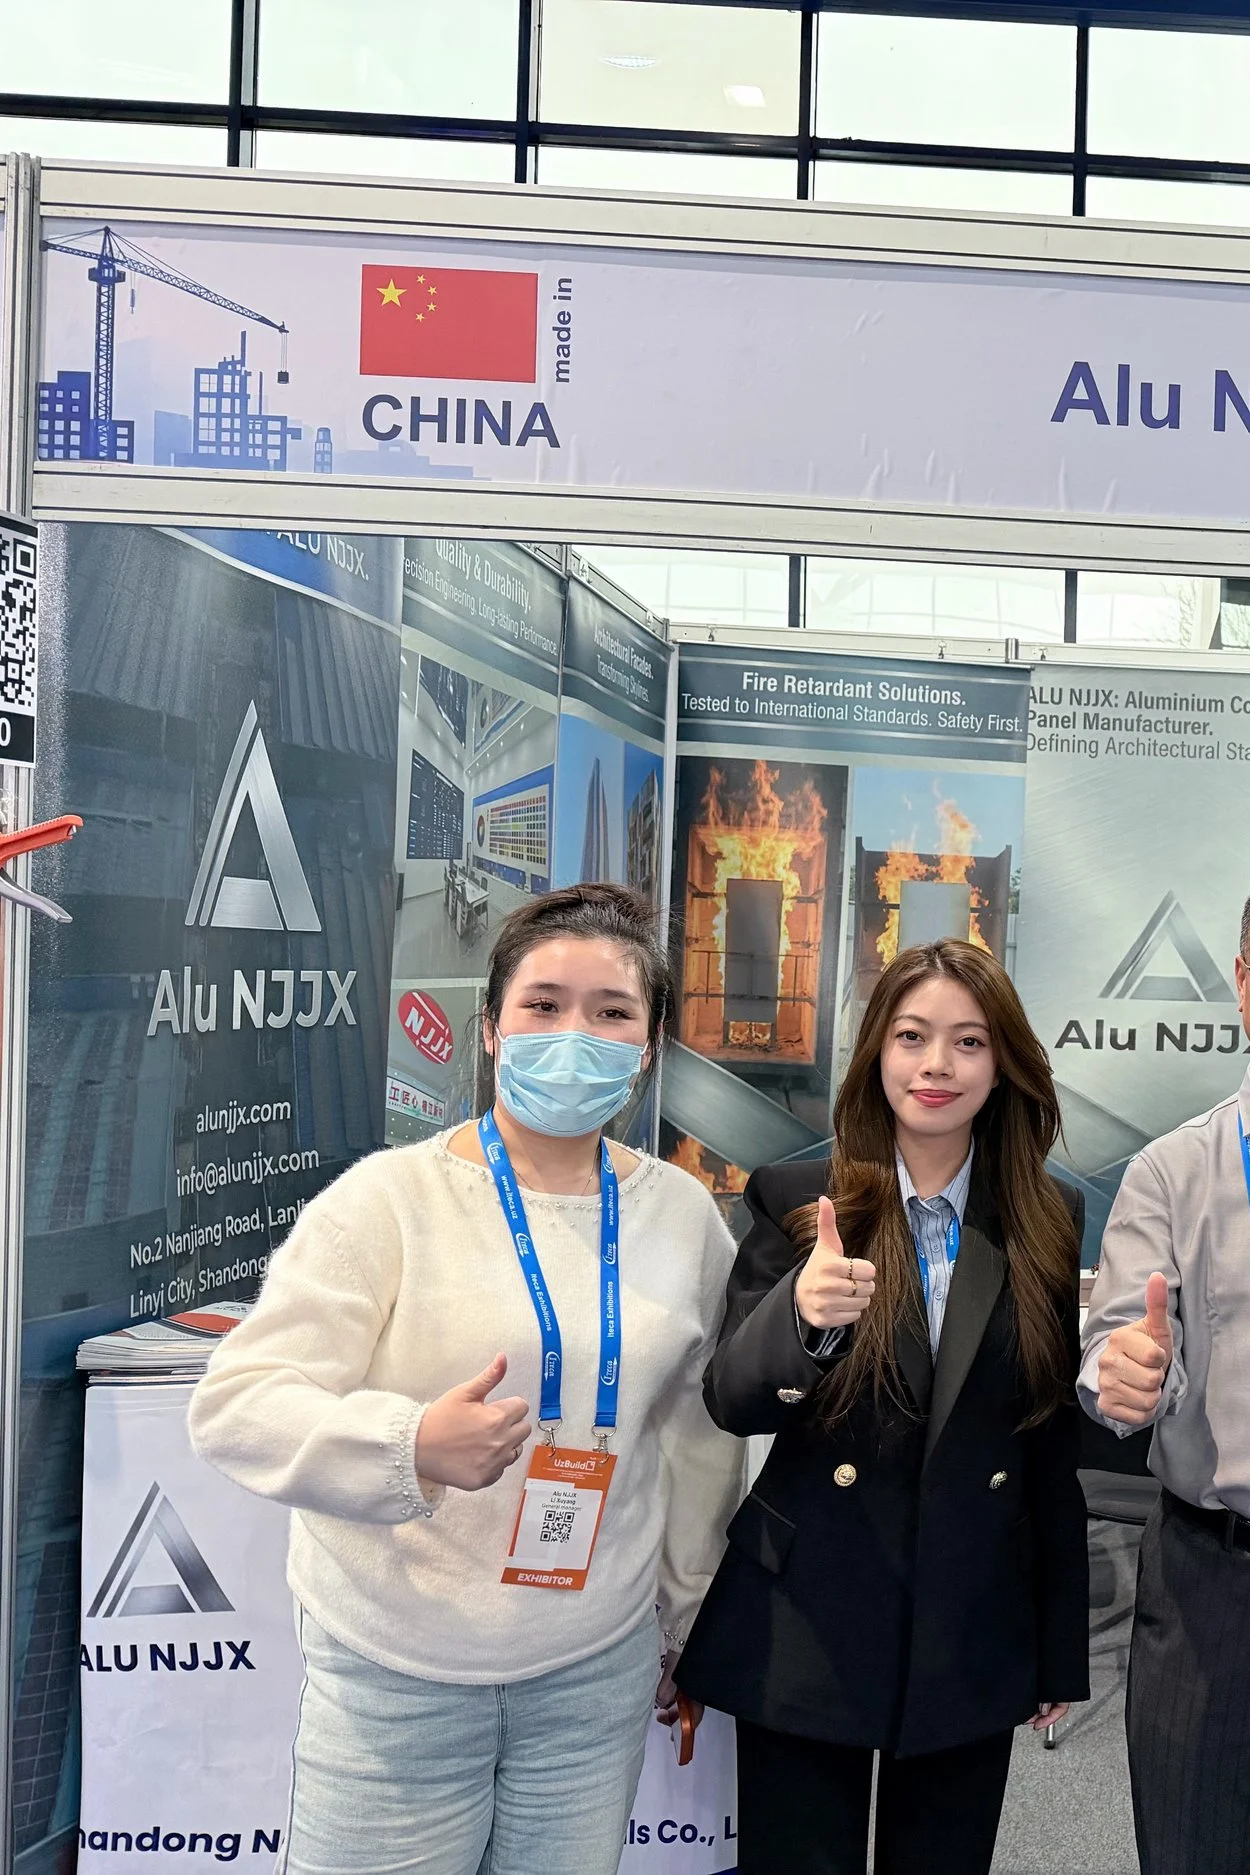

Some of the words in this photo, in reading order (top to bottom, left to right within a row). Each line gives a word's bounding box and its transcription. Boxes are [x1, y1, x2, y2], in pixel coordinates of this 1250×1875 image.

[553, 278, 572, 301] in
[552, 310, 571, 383] made
[1051, 361, 1181, 429] Alu
[362, 394, 561, 448] CHINA
[474, 554, 481, 581] &
[485, 559, 532, 615] Durability.
[742, 672, 777, 692] Fire
[784, 674, 873, 700] Retardant
[879, 681, 967, 706] Solutions.
[1069, 688, 1119, 709] NJJX:
[1124, 691, 1225, 714] Aluminium
[682, 693, 731, 713] Tested
[734, 696, 750, 714] to
[754, 698, 849, 721] International
[853, 704, 932, 728] Standards.
[937, 711, 984, 734] Safety
[988, 714, 1024, 734] First.
[1027, 710, 1077, 730] Panel
[1083, 713, 1214, 736] Manufacturer.
[1026, 733, 1100, 760] Defining
[1104, 736, 1220, 760] Architectural
[147, 966, 217, 1036] Alu
[232, 969, 357, 1030] NJJX
[404, 1007, 453, 1060] NJJX
[1054, 1019, 1137, 1051] Alu
[197, 1100, 291, 1134] alunjjx.com
[176, 1149, 319, 1197] info@alunjjx.com
[130, 1236, 163, 1269] No.2
[166, 1222, 222, 1257] Nanjiang
[225, 1207, 264, 1239] Road,
[130, 1283, 164, 1318] Linyi
[167, 1276, 195, 1304] City,
[198, 1255, 268, 1294] Shandong
[606, 1281, 614, 1318] Exhibitions
[536, 1291, 552, 1331] Exhibitions
[554, 1459, 586, 1470] UzBuild
[517, 1573, 573, 1586] EXHIBITOR
[80, 1643, 138, 1672] ALU
[150, 1640, 256, 1672] NJJX
[252, 1829, 285, 1853] N
[624, 1819, 650, 1845] ls
[657, 1819, 715, 1846] Co.,
